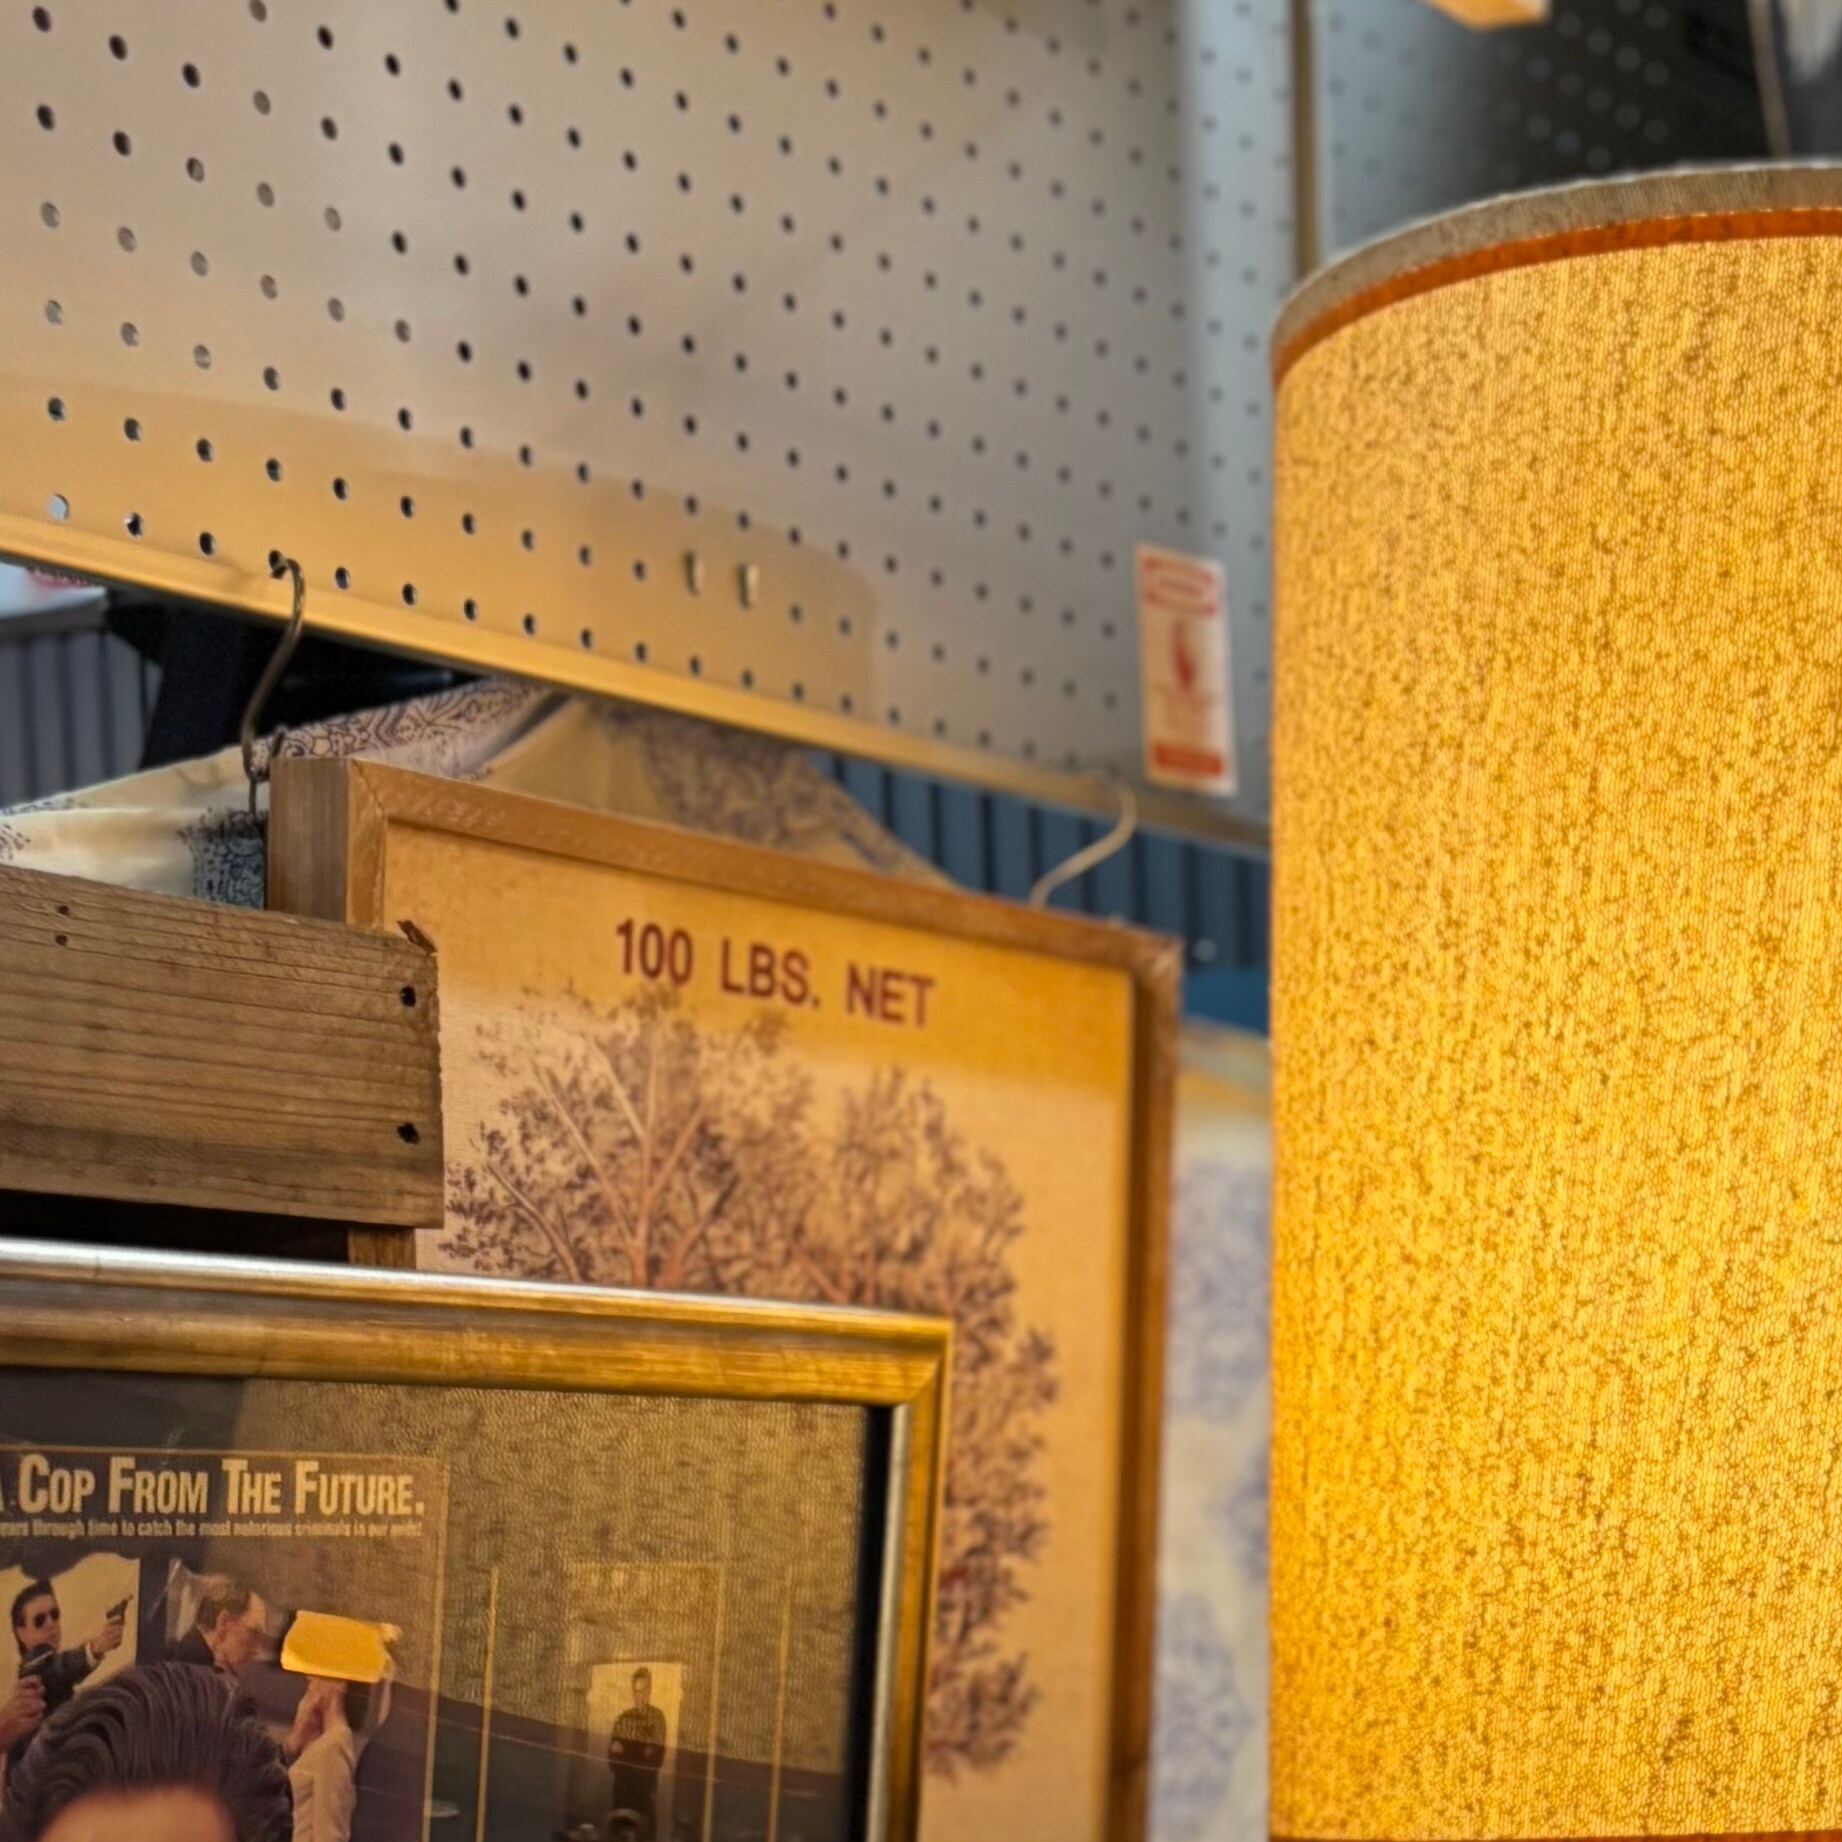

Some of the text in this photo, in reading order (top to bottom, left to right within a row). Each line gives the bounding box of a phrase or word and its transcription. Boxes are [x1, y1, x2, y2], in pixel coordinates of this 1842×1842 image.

[615, 917, 936, 1028] 100 LBS. NET
